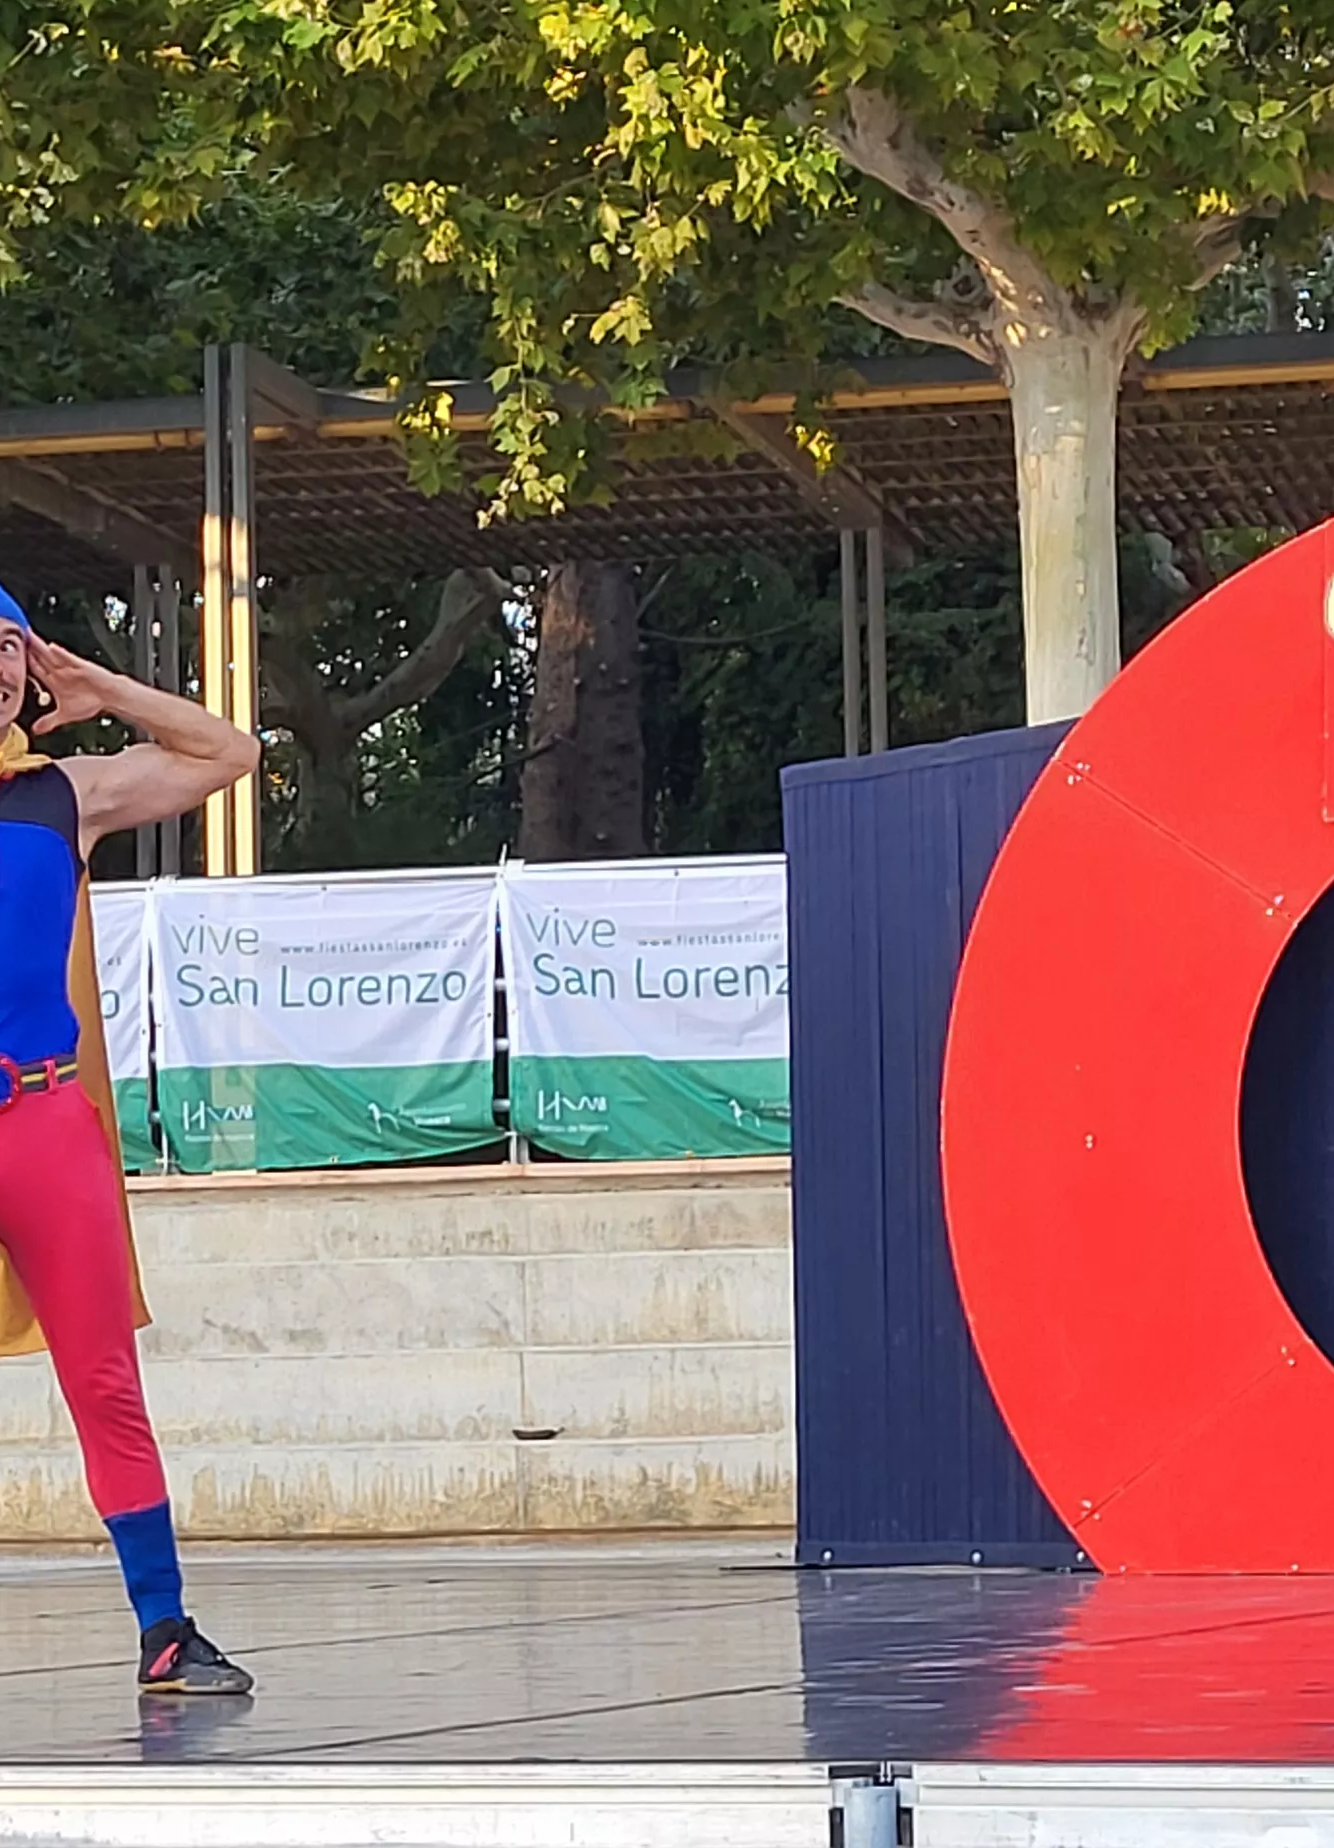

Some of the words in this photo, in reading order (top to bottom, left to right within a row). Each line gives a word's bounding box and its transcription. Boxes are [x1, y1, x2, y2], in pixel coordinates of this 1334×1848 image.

[171, 915, 260, 956] vive
[527, 907, 616, 948] vive
[177, 964, 258, 1007] San
[280, 966, 467, 1008] Lorenzo
[533, 953, 616, 1000] San
[635, 957, 790, 1000] Lorenz
